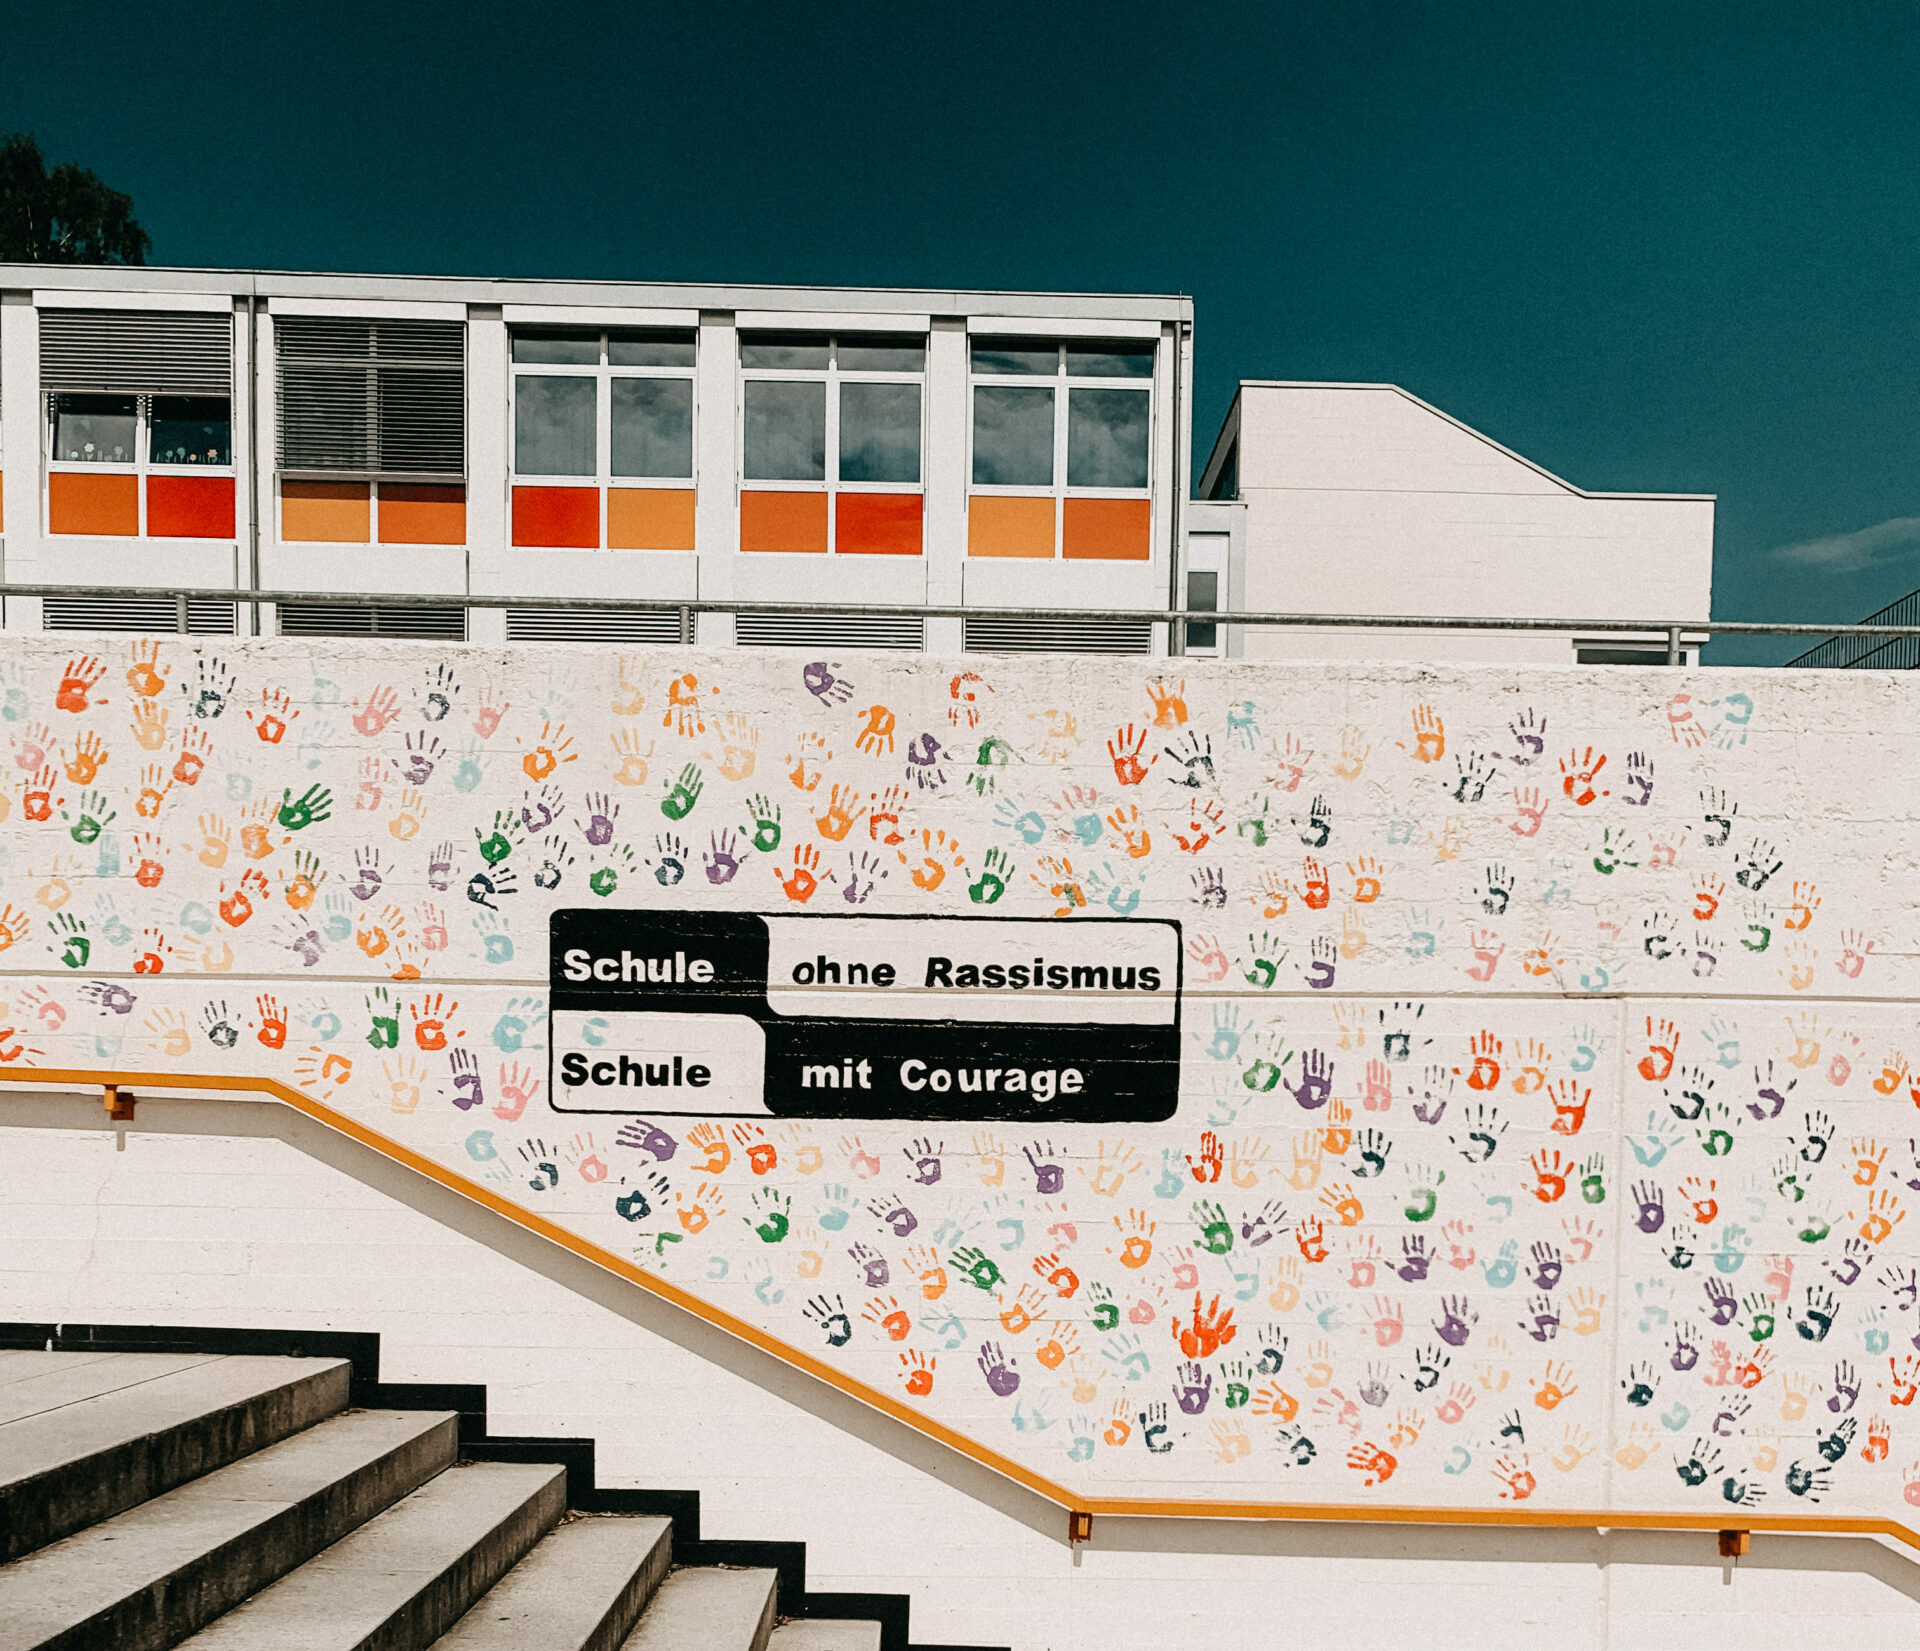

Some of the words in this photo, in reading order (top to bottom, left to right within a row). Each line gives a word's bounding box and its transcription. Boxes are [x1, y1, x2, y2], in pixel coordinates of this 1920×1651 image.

[563, 948, 715, 983] Schule
[791, 954, 897, 988] ohne
[924, 956, 1161, 992] Rassismus
[561, 1052, 712, 1088] Schule
[801, 1058, 872, 1089] mit
[899, 1059, 1084, 1103] Courage
